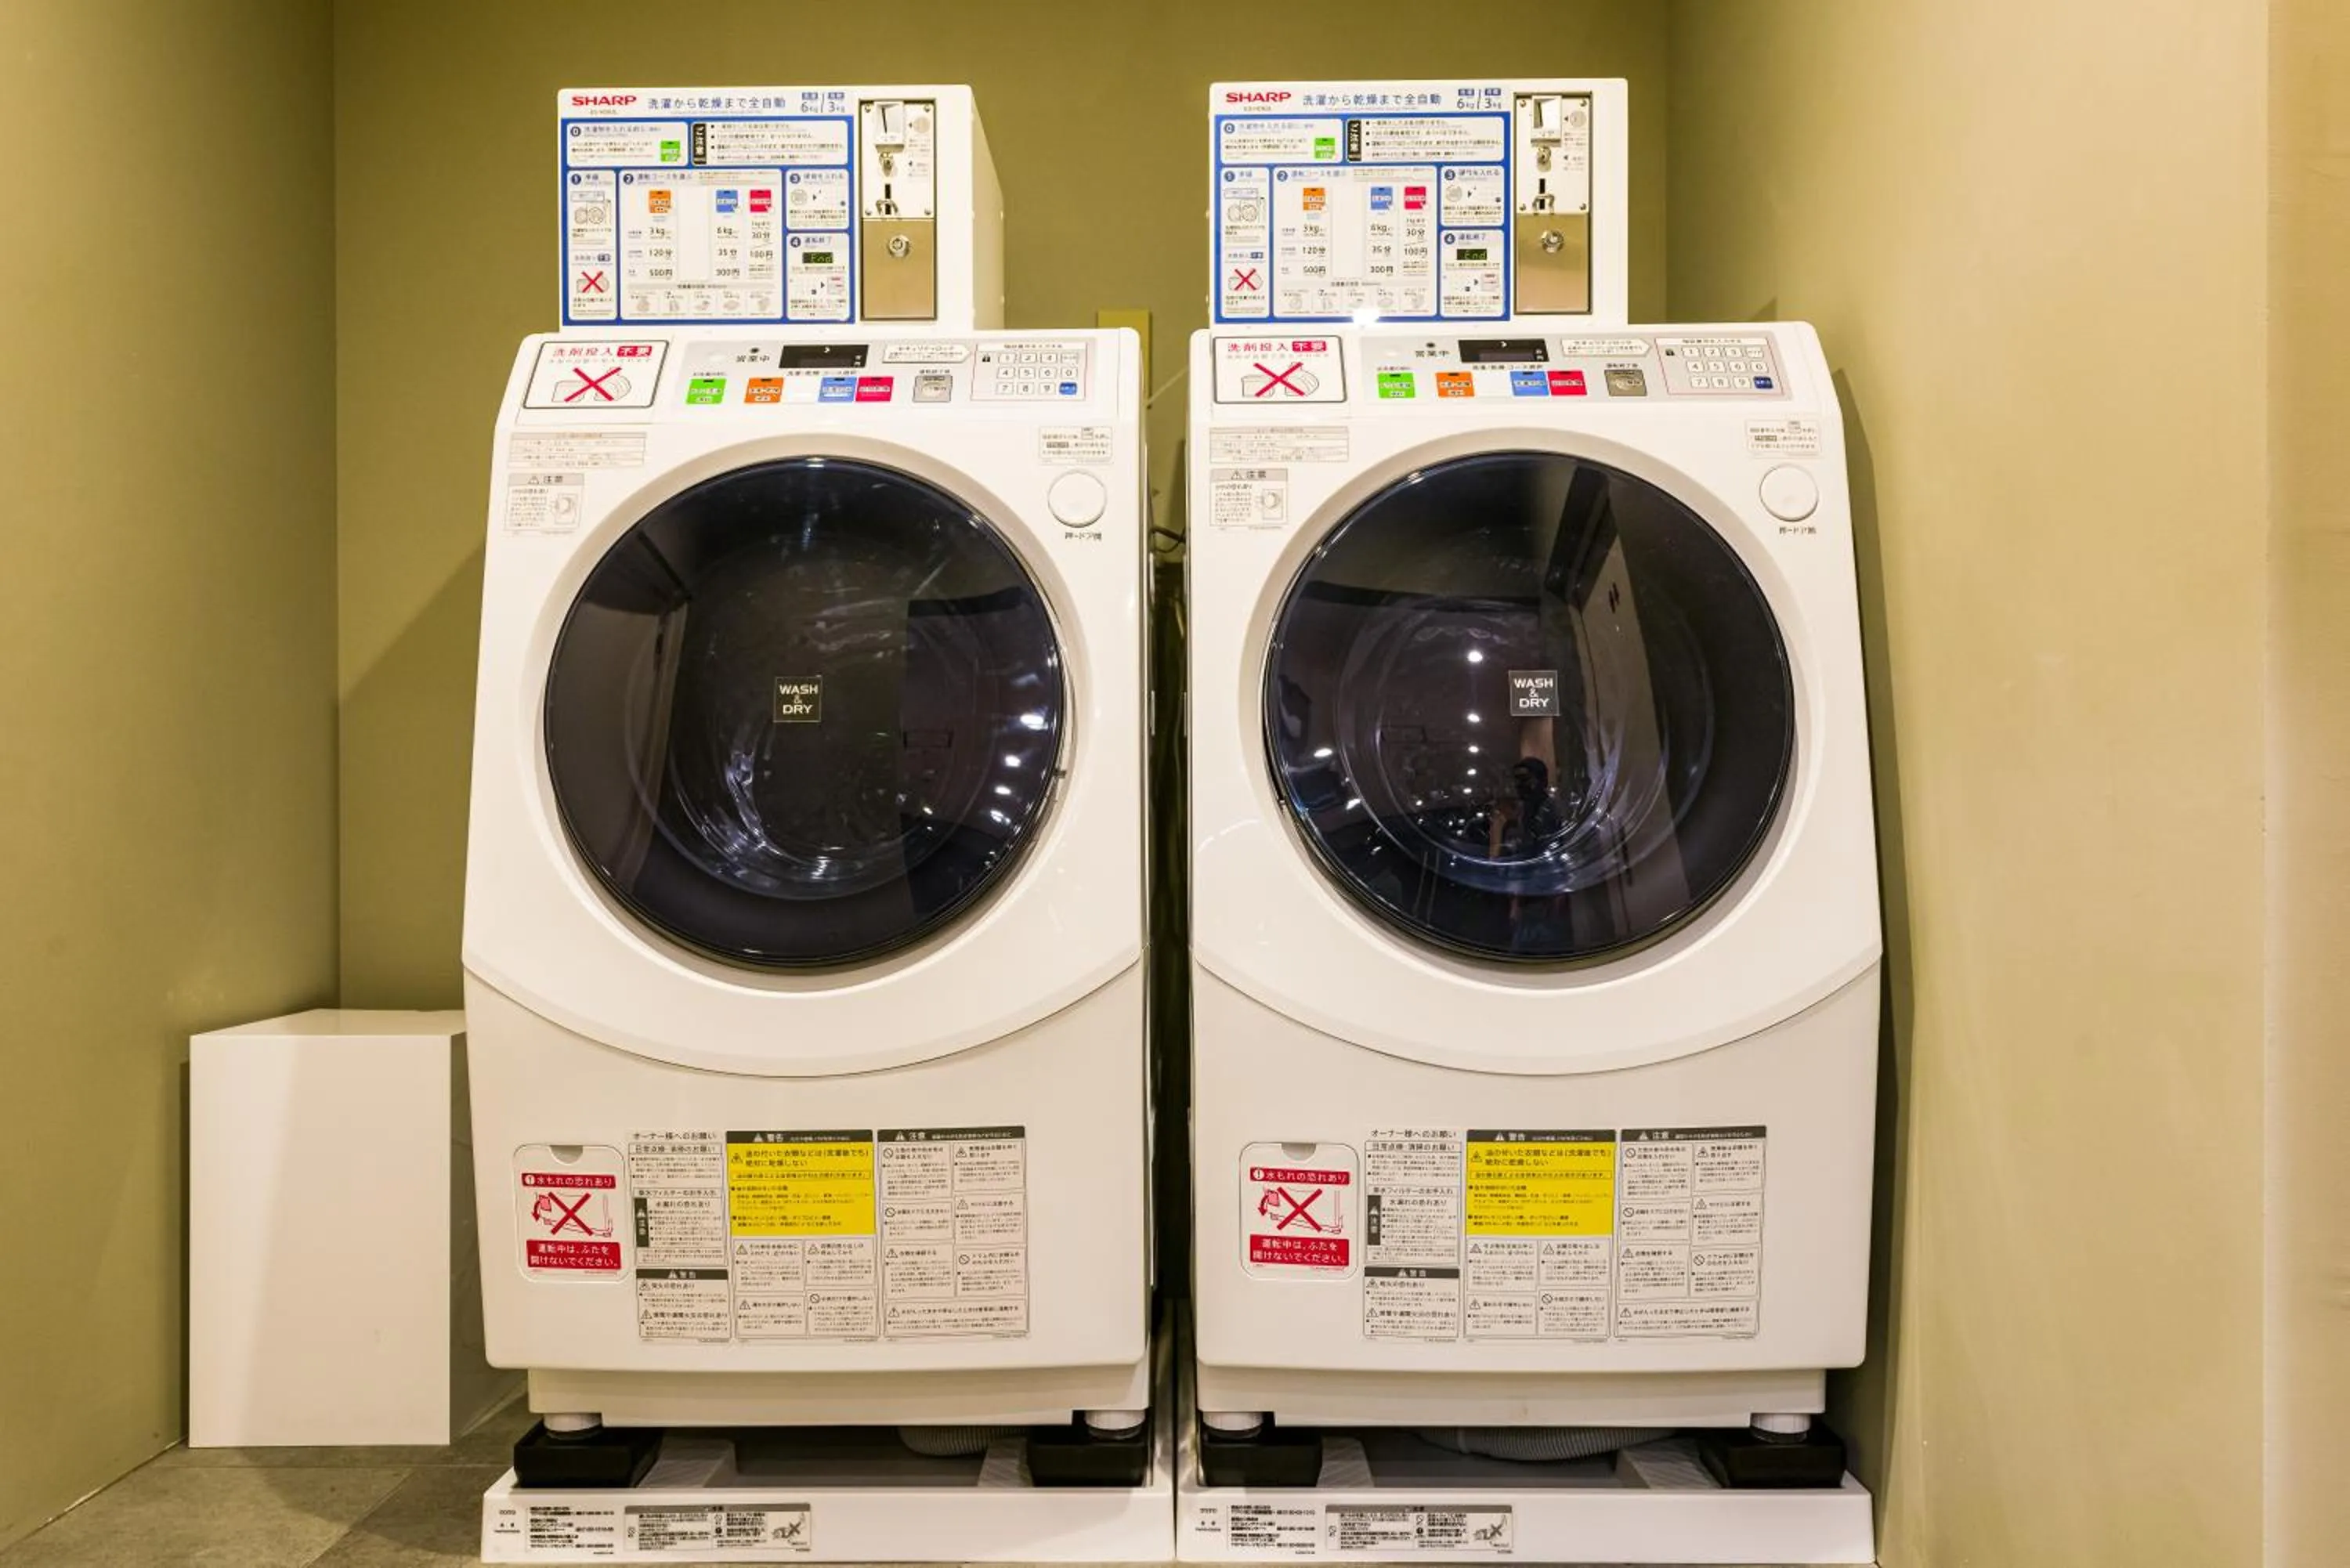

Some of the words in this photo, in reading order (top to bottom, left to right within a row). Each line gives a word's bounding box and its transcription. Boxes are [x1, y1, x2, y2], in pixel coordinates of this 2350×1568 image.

[572, 96, 637, 107] SHARP
[1226, 92, 1292, 103] SHARP
[1302, 93, 1442, 106] 洗濯から乾燥まで全自動
[648, 97, 786, 110] 洗濯から乾燥まで全自動
[1514, 677, 1553, 688] WASH
[779, 684, 819, 695] WASH
[1529, 688, 1538, 697] &
[794, 695, 803, 703] &
[1519, 698, 1550, 708] DRY
[783, 704, 813, 714] DRY
[537, 1176, 613, 1187] 水もれの恐れあり
[1266, 1172, 1347, 1183] 水もれの恐れあり
